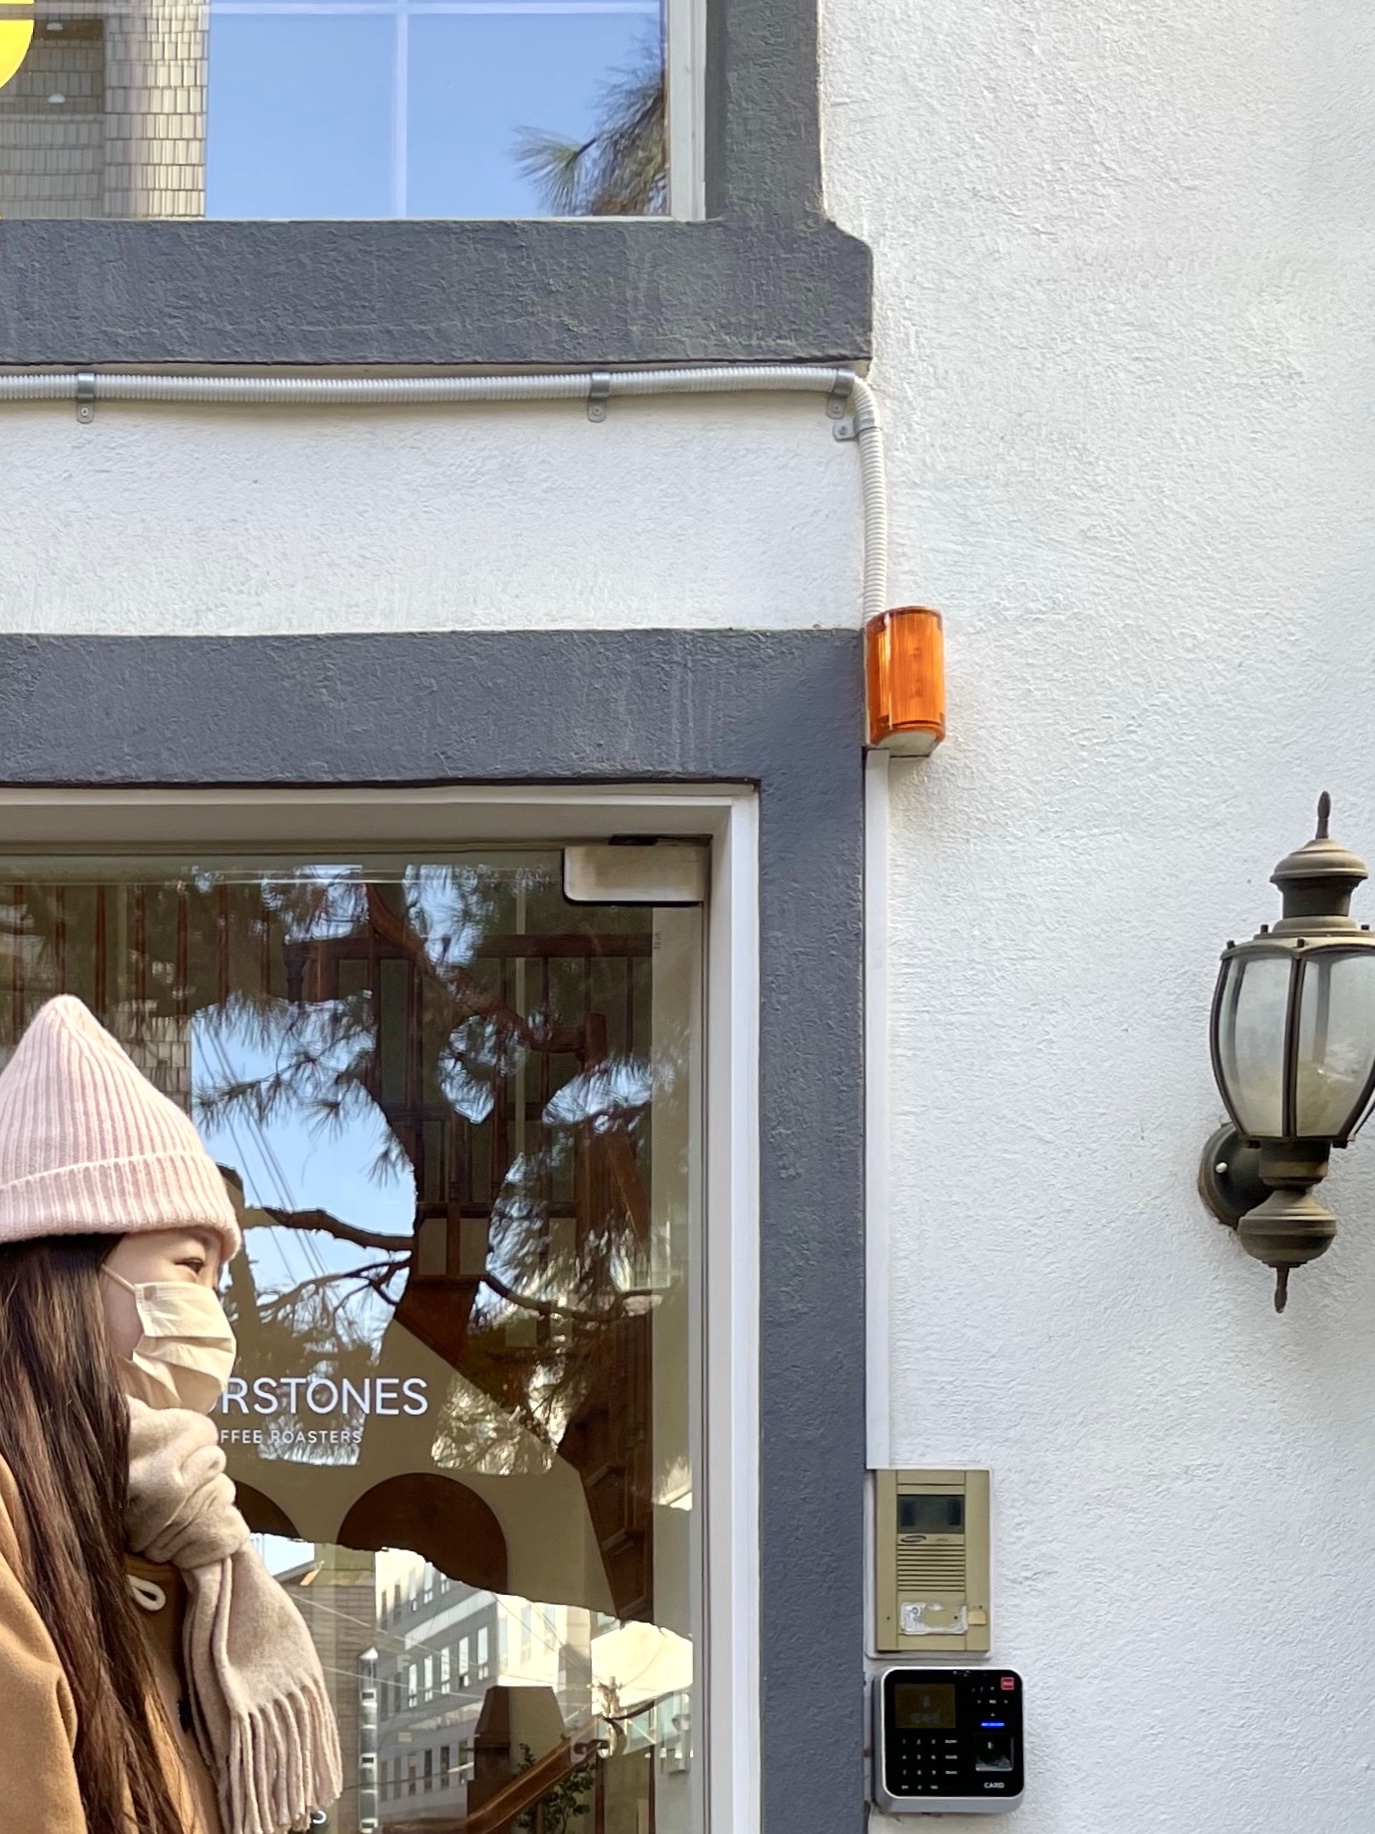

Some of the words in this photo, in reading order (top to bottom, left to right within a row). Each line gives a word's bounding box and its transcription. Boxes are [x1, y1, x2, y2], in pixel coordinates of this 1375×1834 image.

[221, 1376, 429, 1416] RSTONES
[220, 1429, 263, 1444] FFEE
[270, 1429, 363, 1445] ROASTERS
